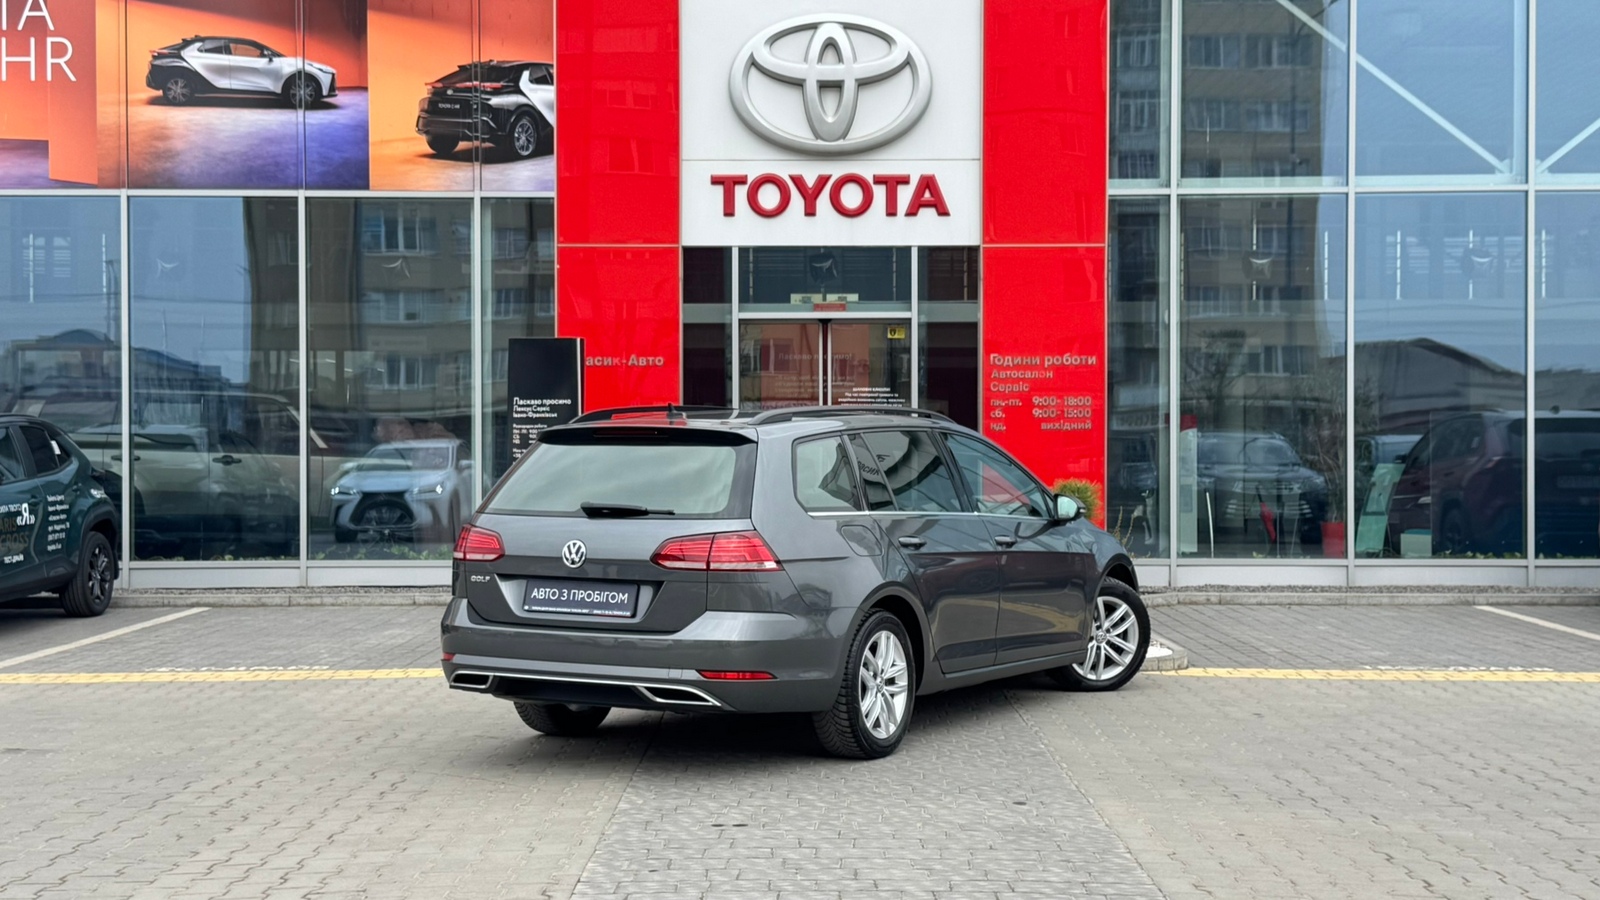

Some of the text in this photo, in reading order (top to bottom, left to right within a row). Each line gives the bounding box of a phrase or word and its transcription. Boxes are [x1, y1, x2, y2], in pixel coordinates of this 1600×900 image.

[710, 172, 951, 218] TOYOTA
[585, 354, 664, 367] асик-Авто
[989, 353, 1097, 368] Години роботи
[991, 369, 1053, 379] Автосалон
[990, 381, 1030, 394] Сервіс
[1041, 420, 1092, 431] вихідний
[470, 575, 491, 583] GOLF
[530, 587, 629, 605] АВТО З ПРОБІГОМ
